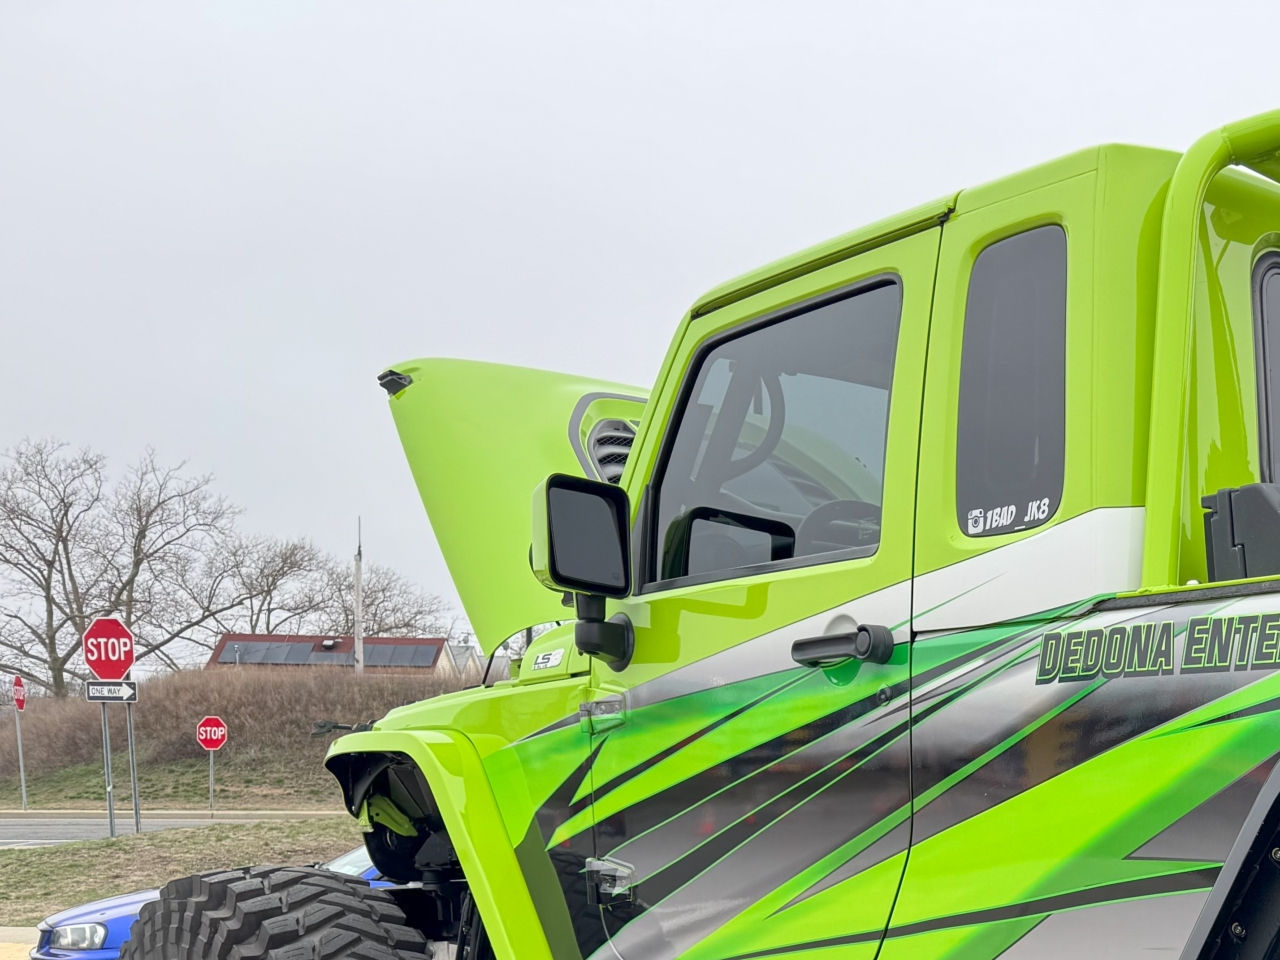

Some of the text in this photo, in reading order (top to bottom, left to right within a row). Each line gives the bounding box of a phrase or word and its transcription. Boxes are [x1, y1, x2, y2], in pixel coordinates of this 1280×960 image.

[87, 637, 131, 661] STOP
[1035, 621, 1174, 685] DEDONA
[91, 687, 121, 696] ONE WAY
[199, 727, 225, 740] STOP
